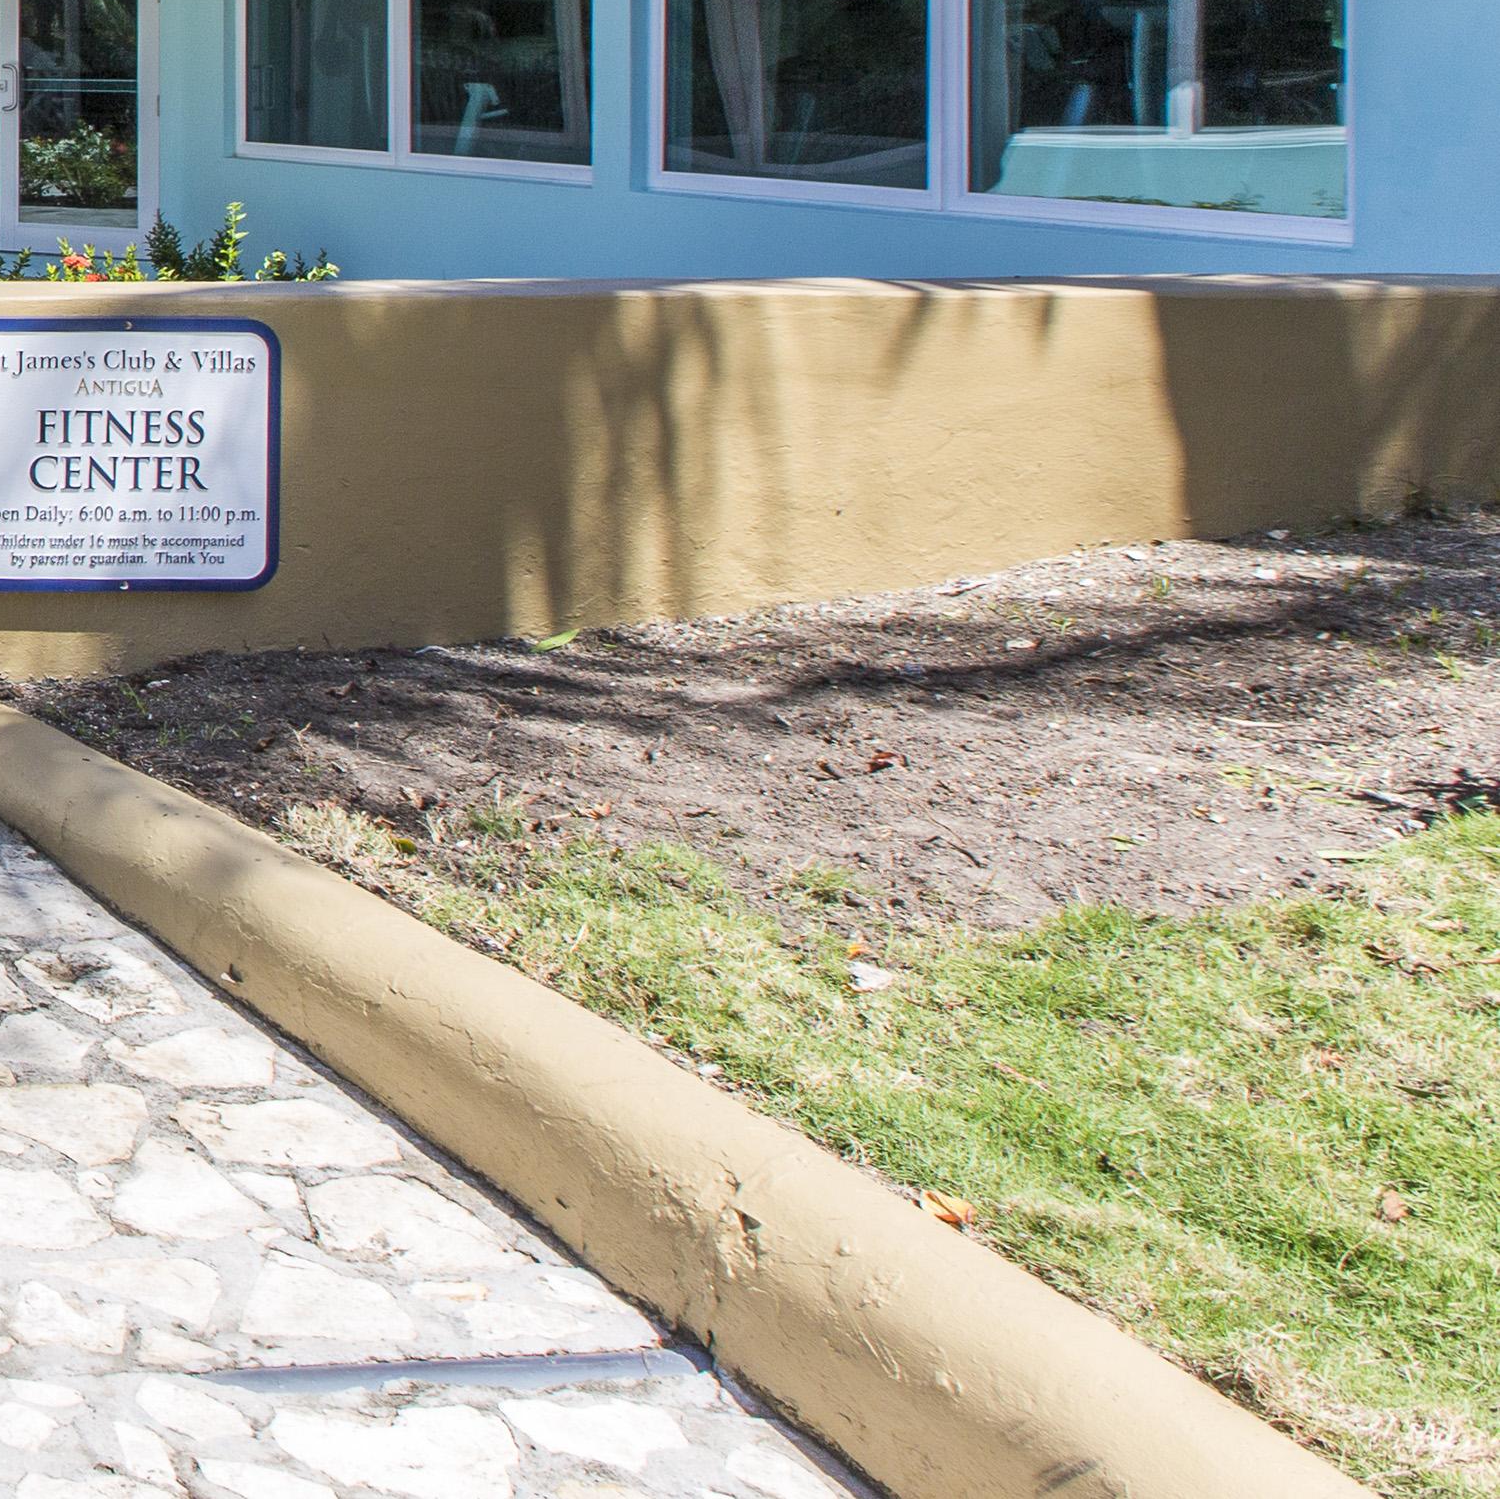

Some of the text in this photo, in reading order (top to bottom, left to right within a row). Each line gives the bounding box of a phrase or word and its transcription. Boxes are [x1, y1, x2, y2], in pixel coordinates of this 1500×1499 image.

[12, 350, 96, 377] James's
[103, 349, 156, 372] Club
[165, 350, 183, 372] &
[191, 350, 256, 373] Villas
[76, 378, 164, 397] ANTIGUA
[36, 409, 205, 447] FITNESS
[29, 455, 209, 493] CENTER
[25, 505, 74, 526] Daily:
[79, 505, 114, 521] 6:00
[119, 508, 152, 521] a.m.
[157, 507, 173, 521] to
[179, 505, 221, 521] 11:00
[225, 509, 260, 525] p.m.
[49, 534, 85, 549] under
[89, 534, 104, 548] 16
[107, 535, 139, 548] must
[142, 534, 158, 547] be
[161, 534, 245, 549] accompanied
[11, 551, 225, 569] by parent or guardian. Thank You
